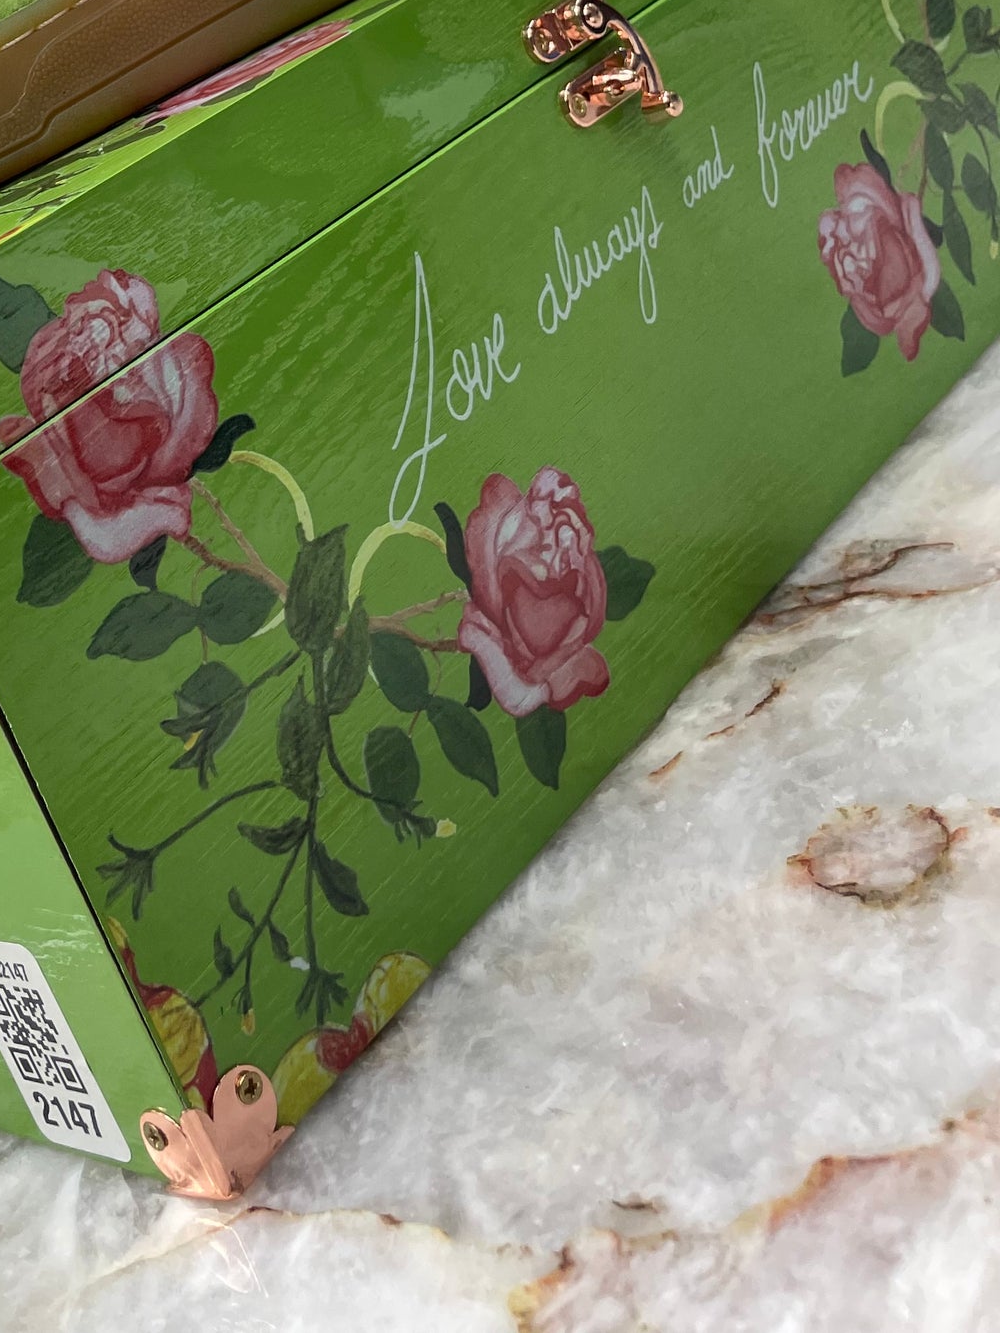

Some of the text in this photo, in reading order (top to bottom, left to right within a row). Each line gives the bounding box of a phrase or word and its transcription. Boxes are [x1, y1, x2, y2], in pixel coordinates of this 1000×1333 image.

[389, 60, 873, 528] Love always and forever
[32, 1091, 103, 1138] 2147
